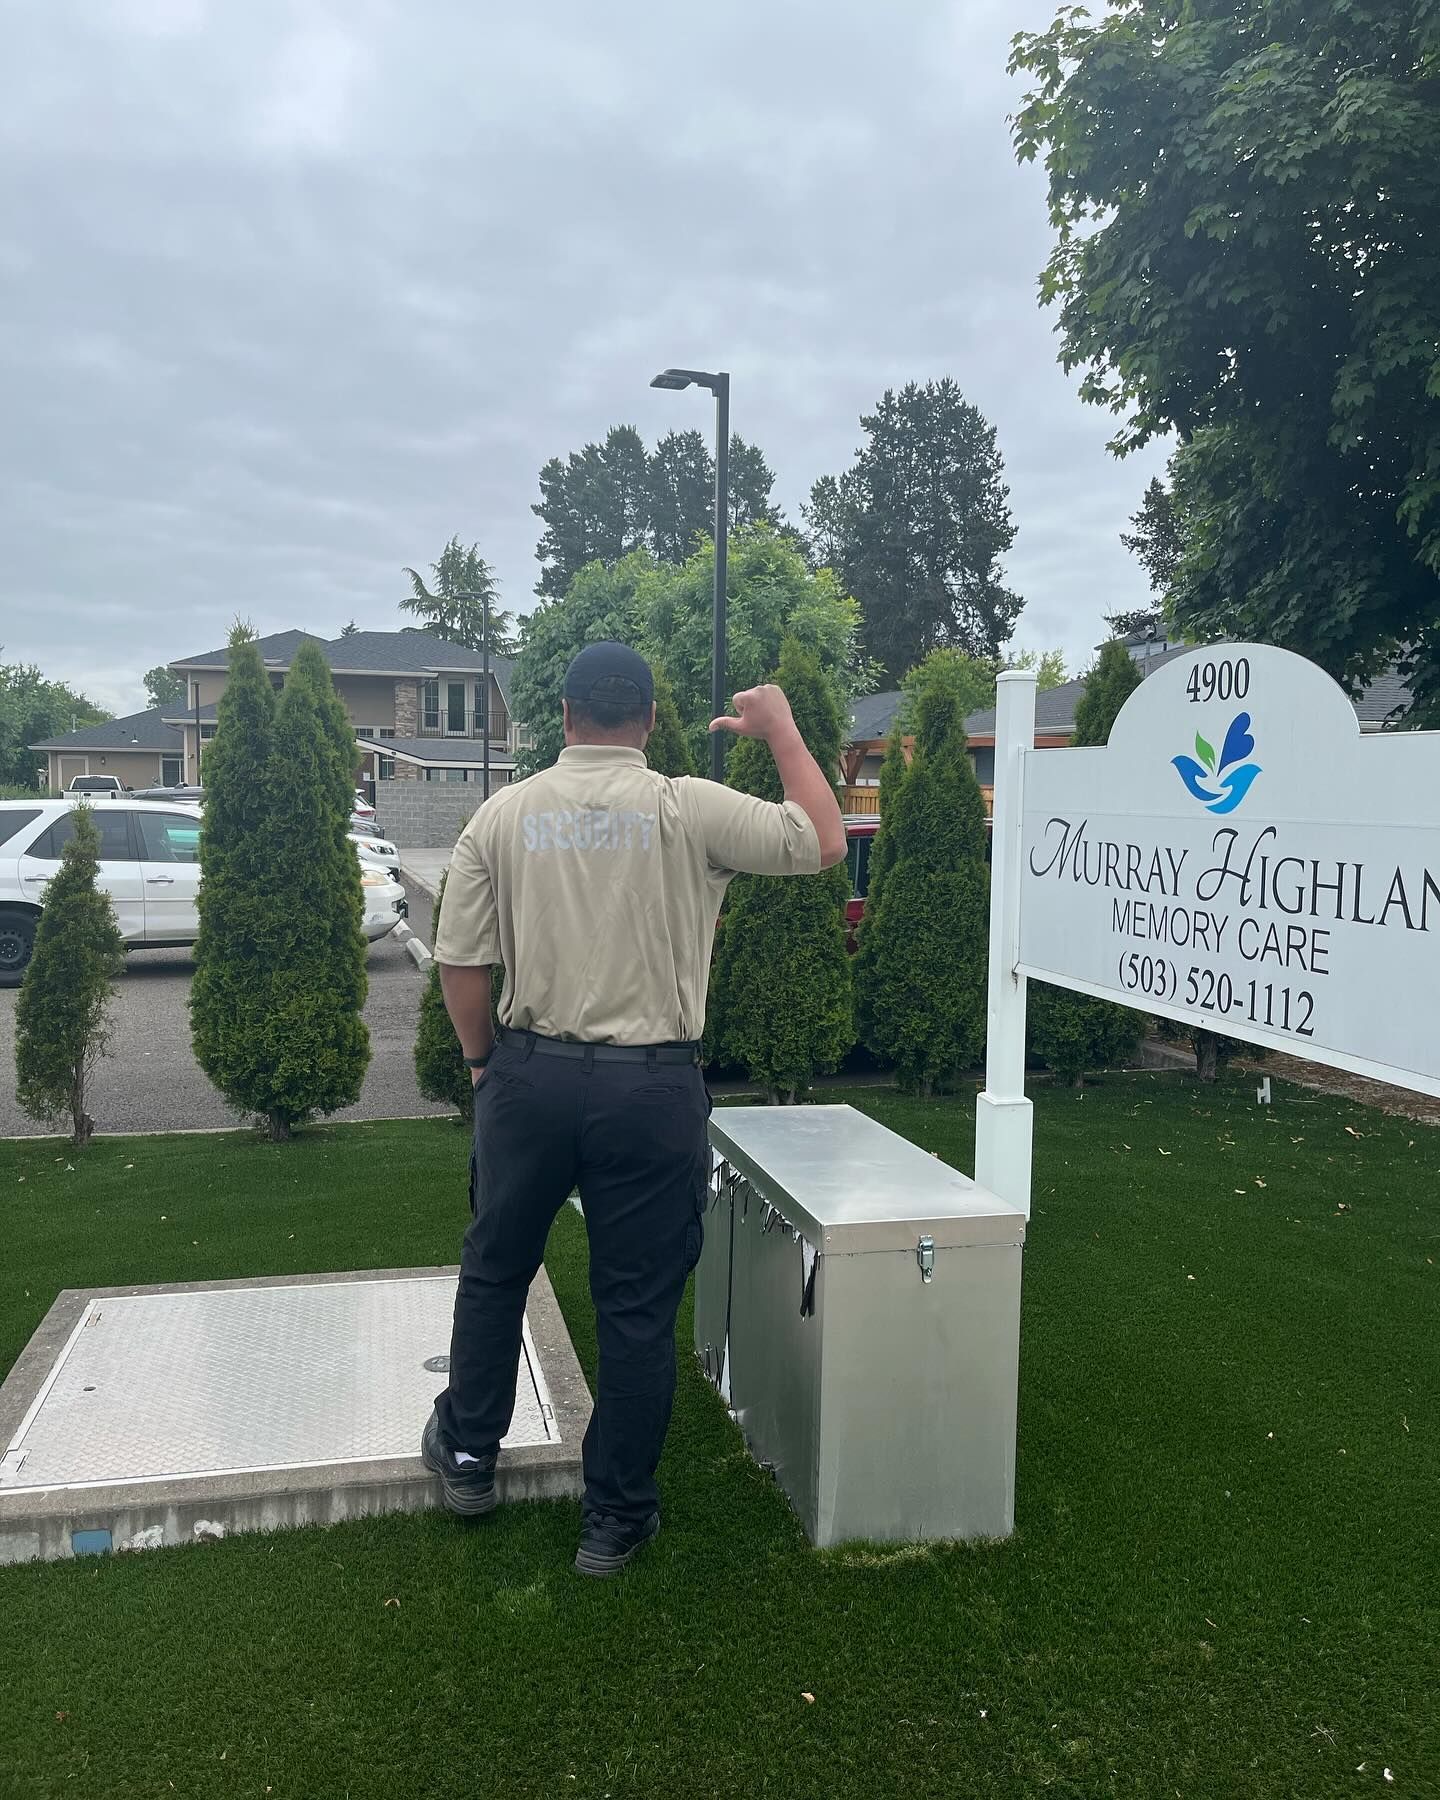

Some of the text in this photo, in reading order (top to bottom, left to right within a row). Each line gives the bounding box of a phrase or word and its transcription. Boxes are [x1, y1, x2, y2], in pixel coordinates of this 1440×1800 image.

[1186, 657, 1250, 703] 4900
[522, 809, 657, 852] SECURITY
[1029, 817, 1189, 897] MURRAY
[1112, 897, 1331, 976] MEMORY CARE
[1118, 950, 1315, 1037] (503) 520-1112
